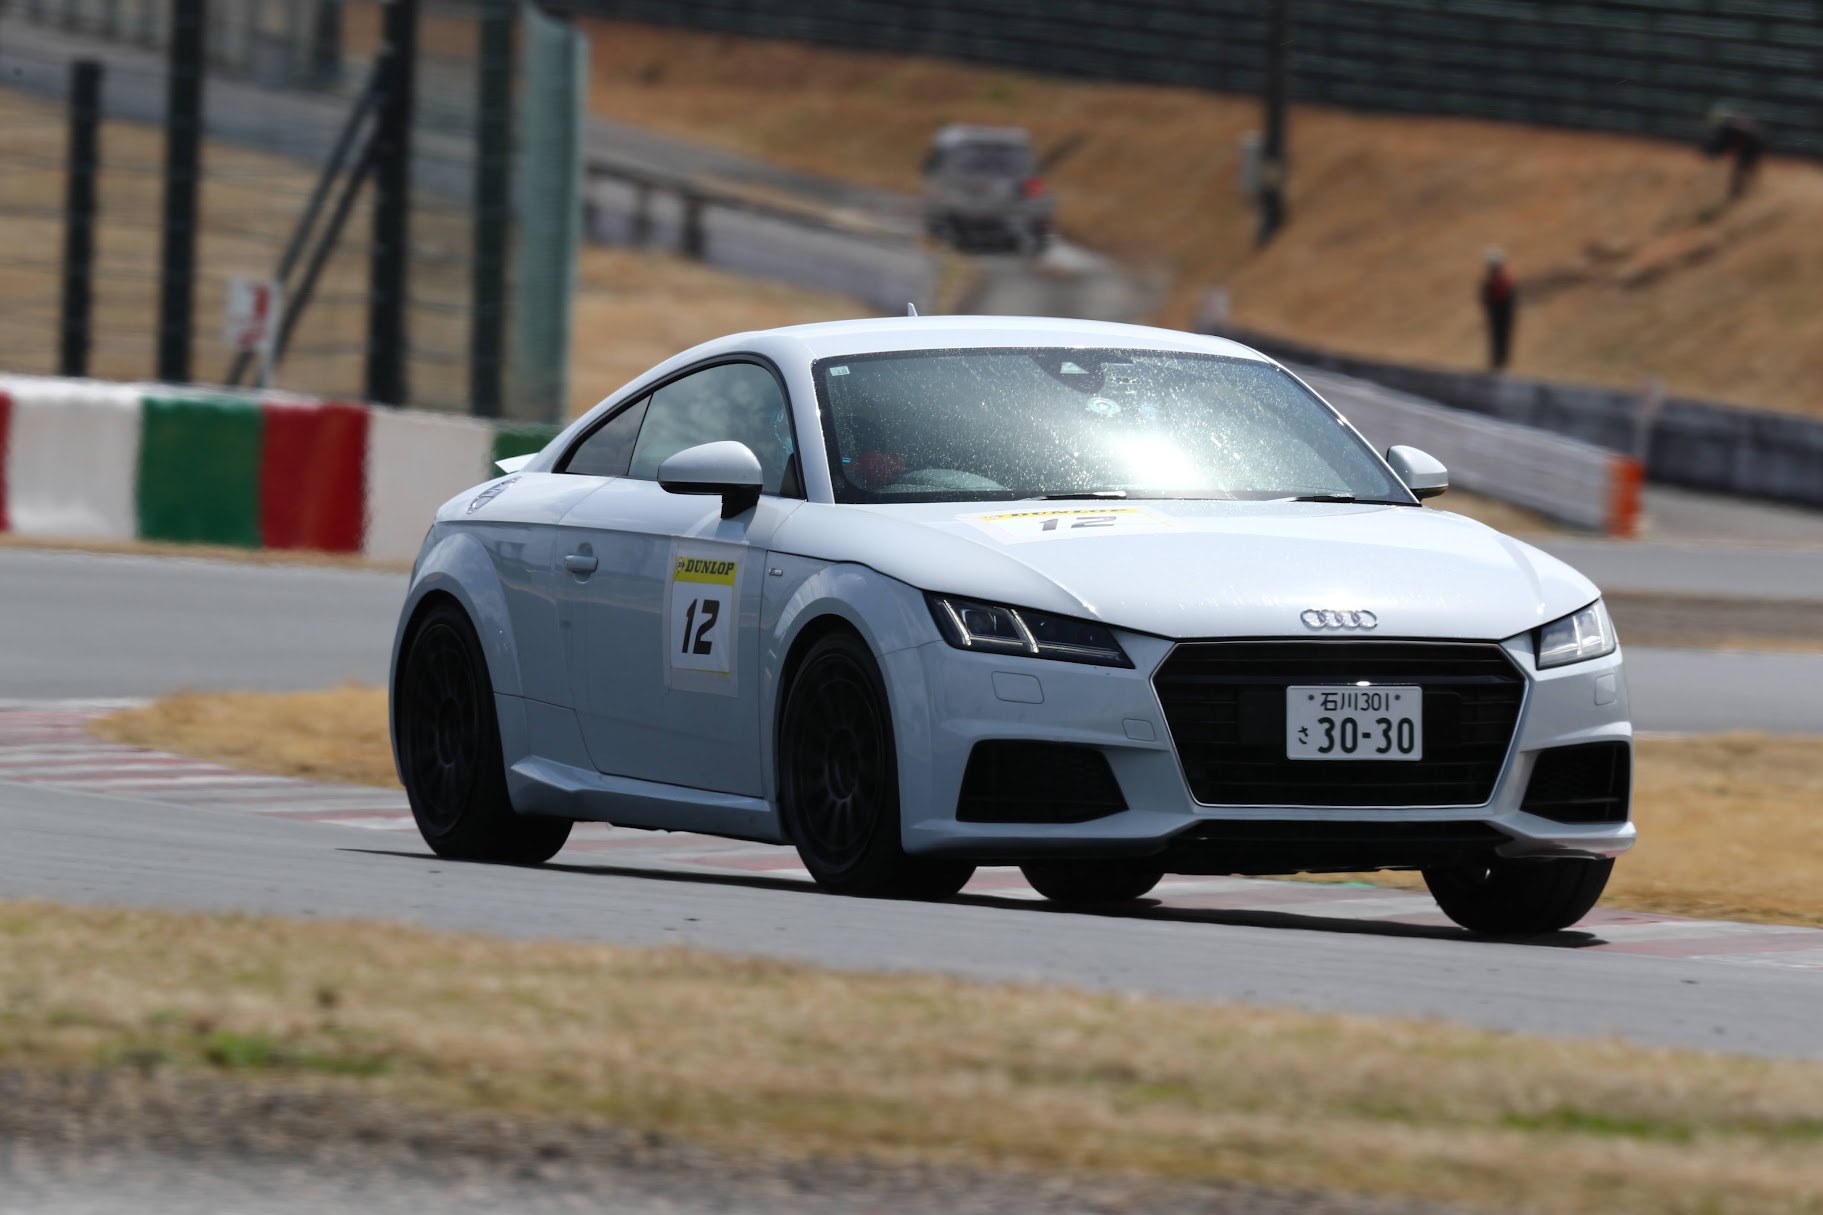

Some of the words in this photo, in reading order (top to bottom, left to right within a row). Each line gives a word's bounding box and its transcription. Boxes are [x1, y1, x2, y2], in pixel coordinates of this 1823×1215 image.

[1039, 516, 1117, 532] 12
[685, 559, 734, 576] DUNLOP
[682, 598, 720, 655] 12
[1298, 726, 1309, 745] さ
[1317, 717, 1414, 754] 30-30
